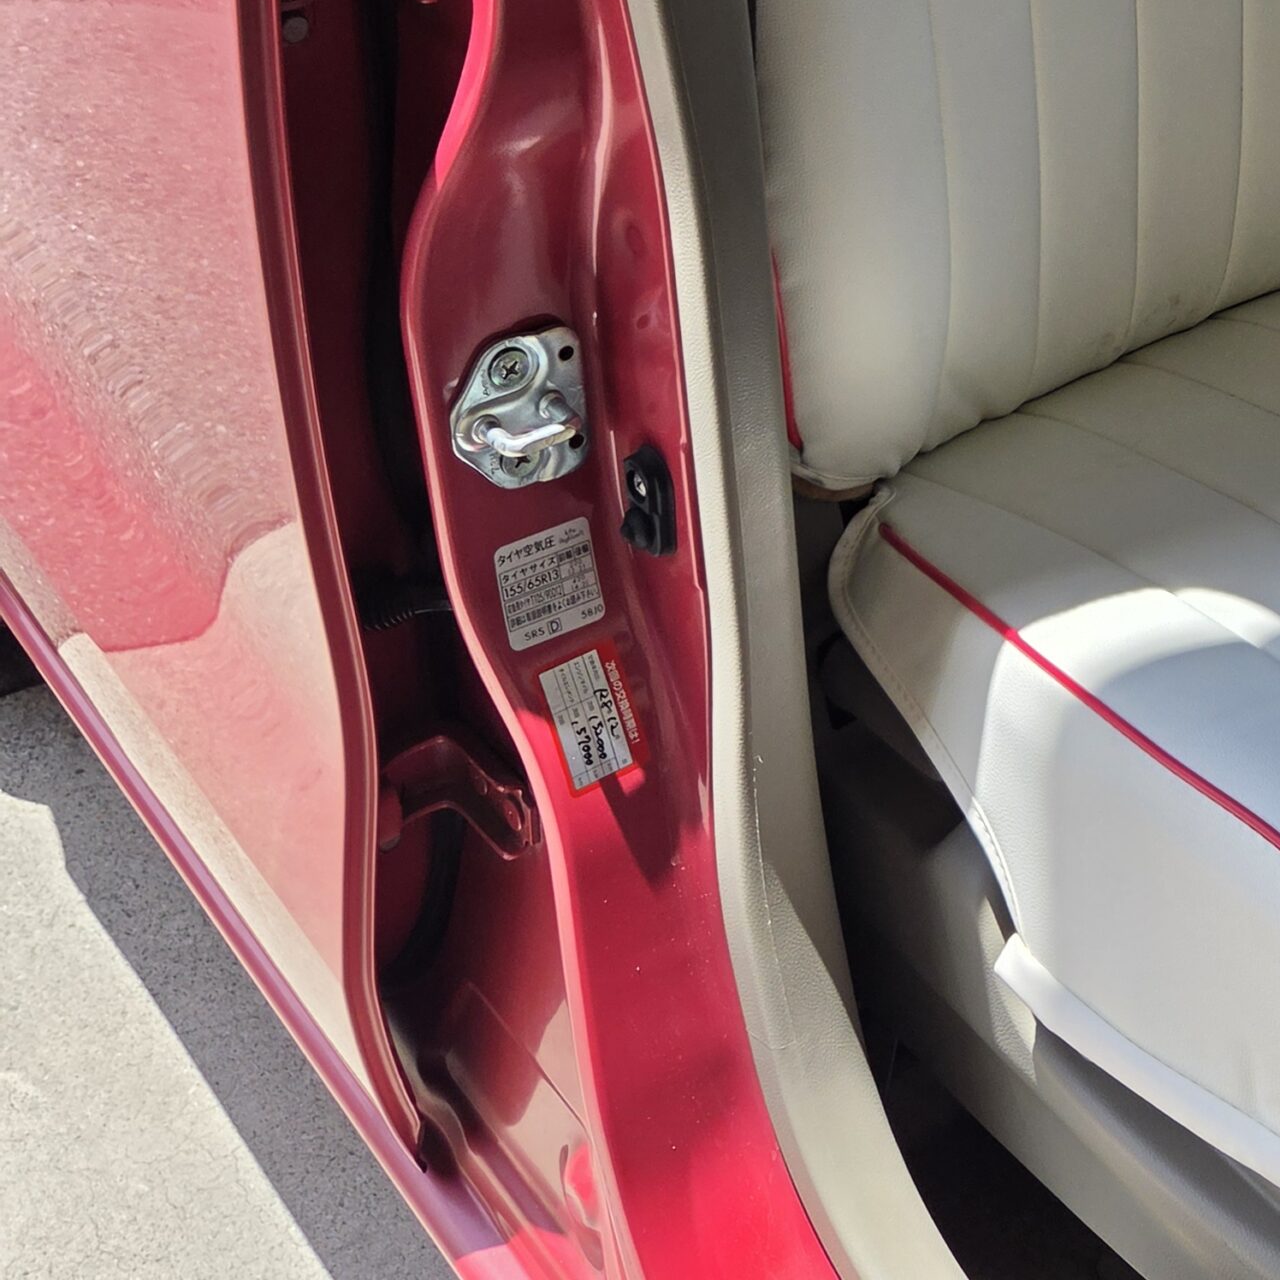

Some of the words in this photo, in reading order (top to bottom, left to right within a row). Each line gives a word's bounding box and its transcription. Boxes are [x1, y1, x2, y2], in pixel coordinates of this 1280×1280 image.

[497, 535, 556, 567] タイヤ空気圧
[504, 568, 560, 599] 155/65R13
[524, 626, 545, 641] SRS
[550, 619, 561, 633] D
